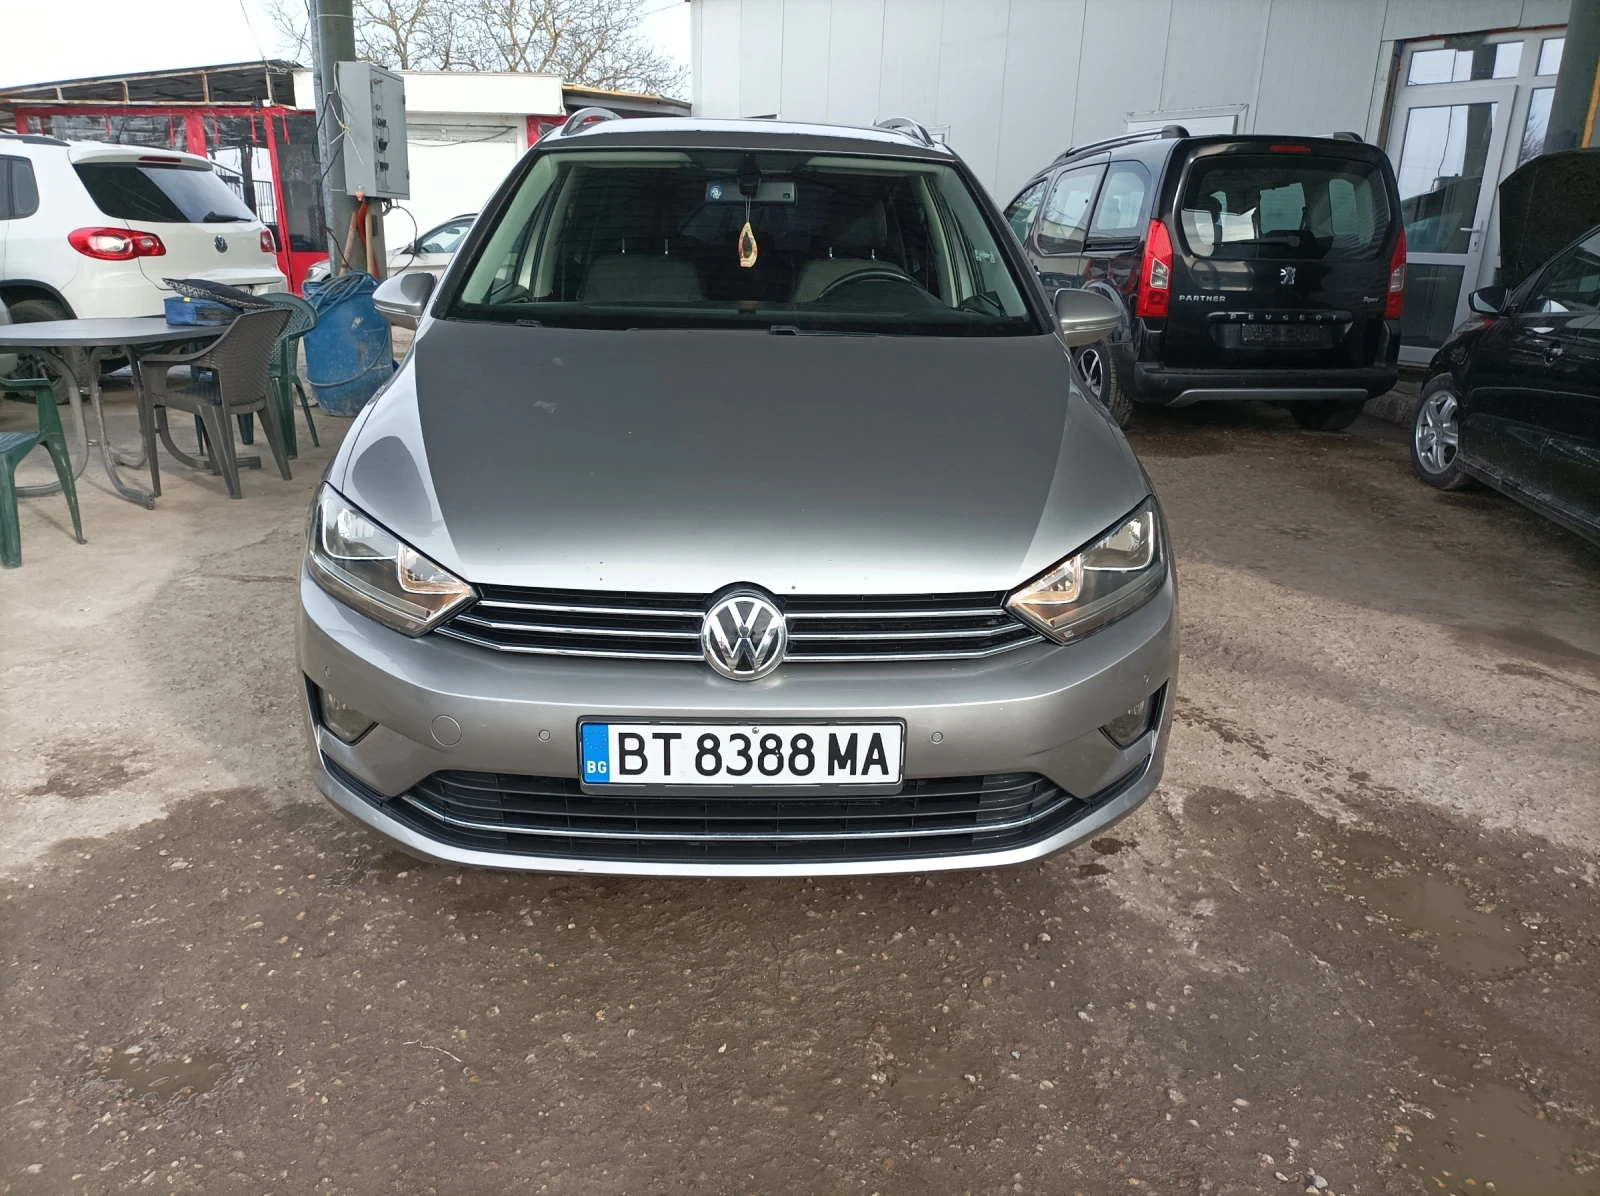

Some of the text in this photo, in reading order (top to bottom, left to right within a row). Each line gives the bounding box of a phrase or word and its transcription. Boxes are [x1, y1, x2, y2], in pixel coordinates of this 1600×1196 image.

[587, 761, 607, 774] BG
[618, 732, 889, 776] BT 8388 MA
